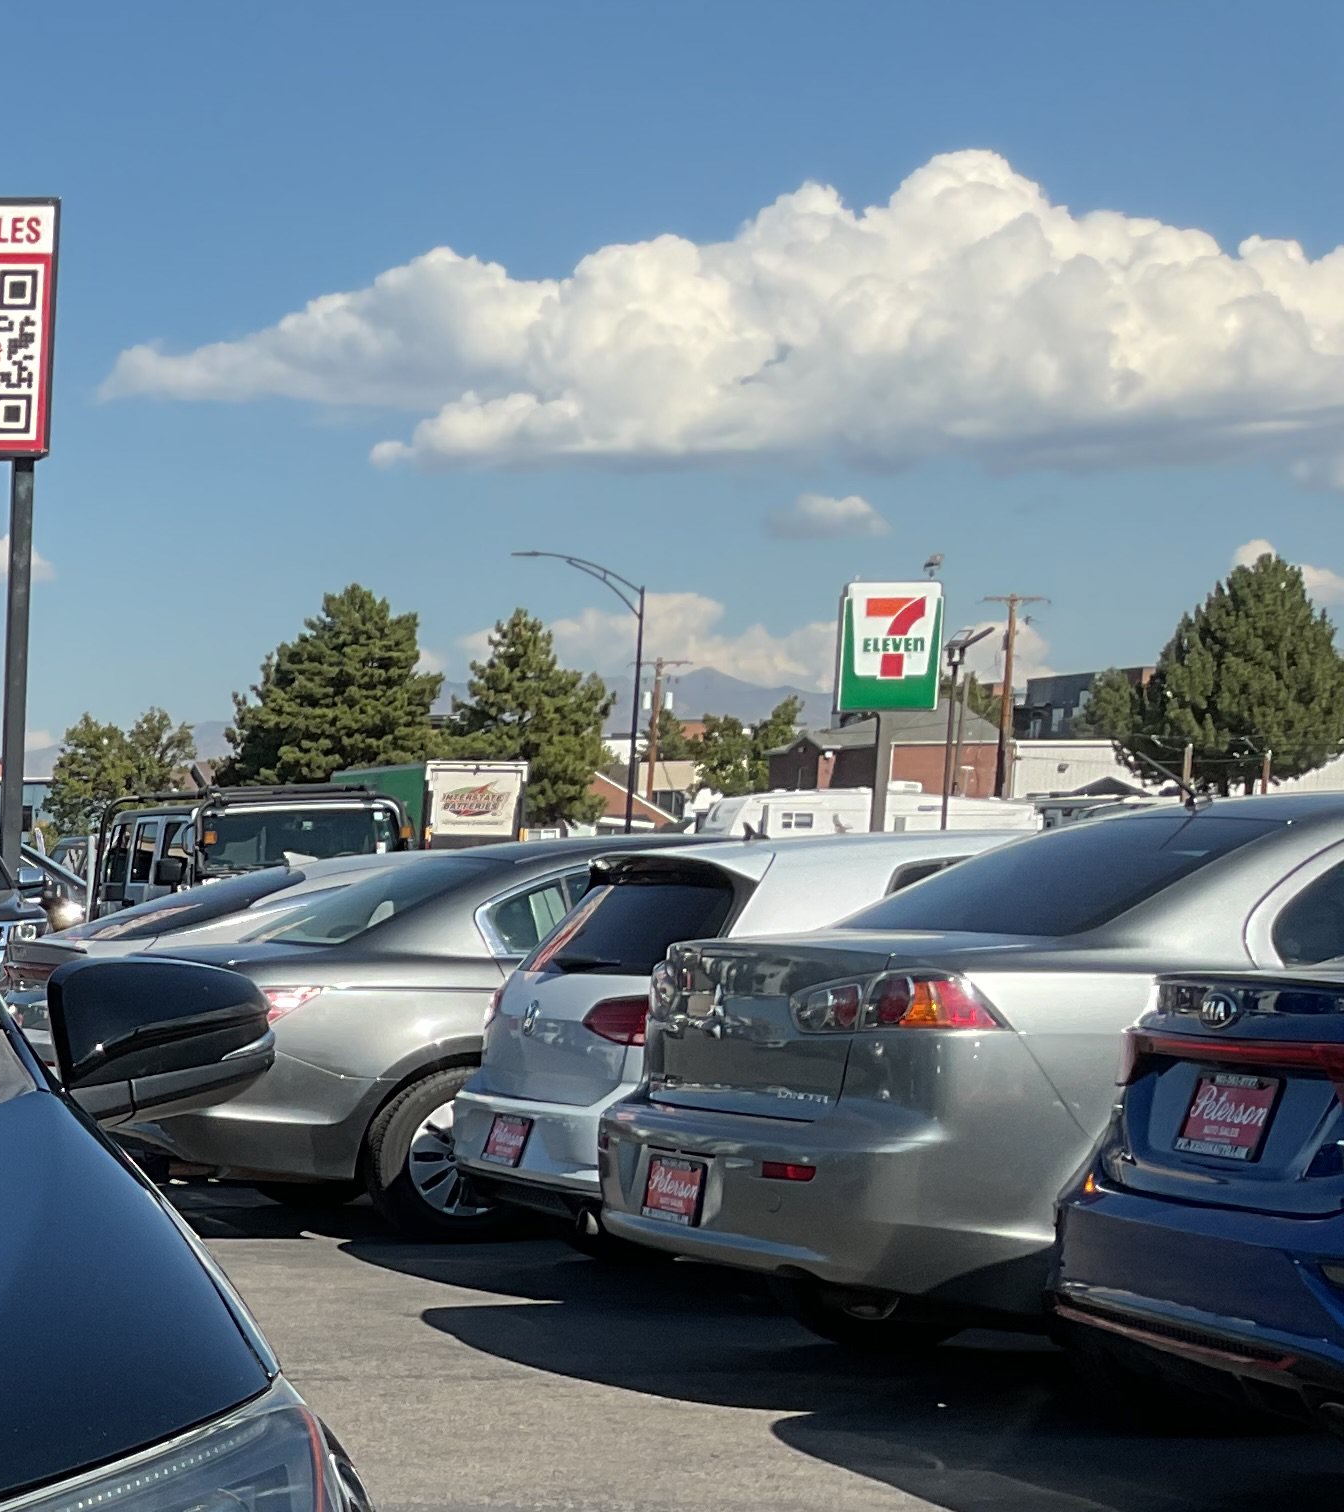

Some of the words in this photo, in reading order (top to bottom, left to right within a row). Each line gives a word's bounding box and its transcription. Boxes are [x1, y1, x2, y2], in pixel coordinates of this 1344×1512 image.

[866, 596, 926, 677] 7
[442, 793, 503, 801] INTERSTATE
[443, 802, 497, 810] BATTERIES
[1202, 1001, 1226, 1020] KIA
[1190, 1085, 1268, 1127] Peterson
